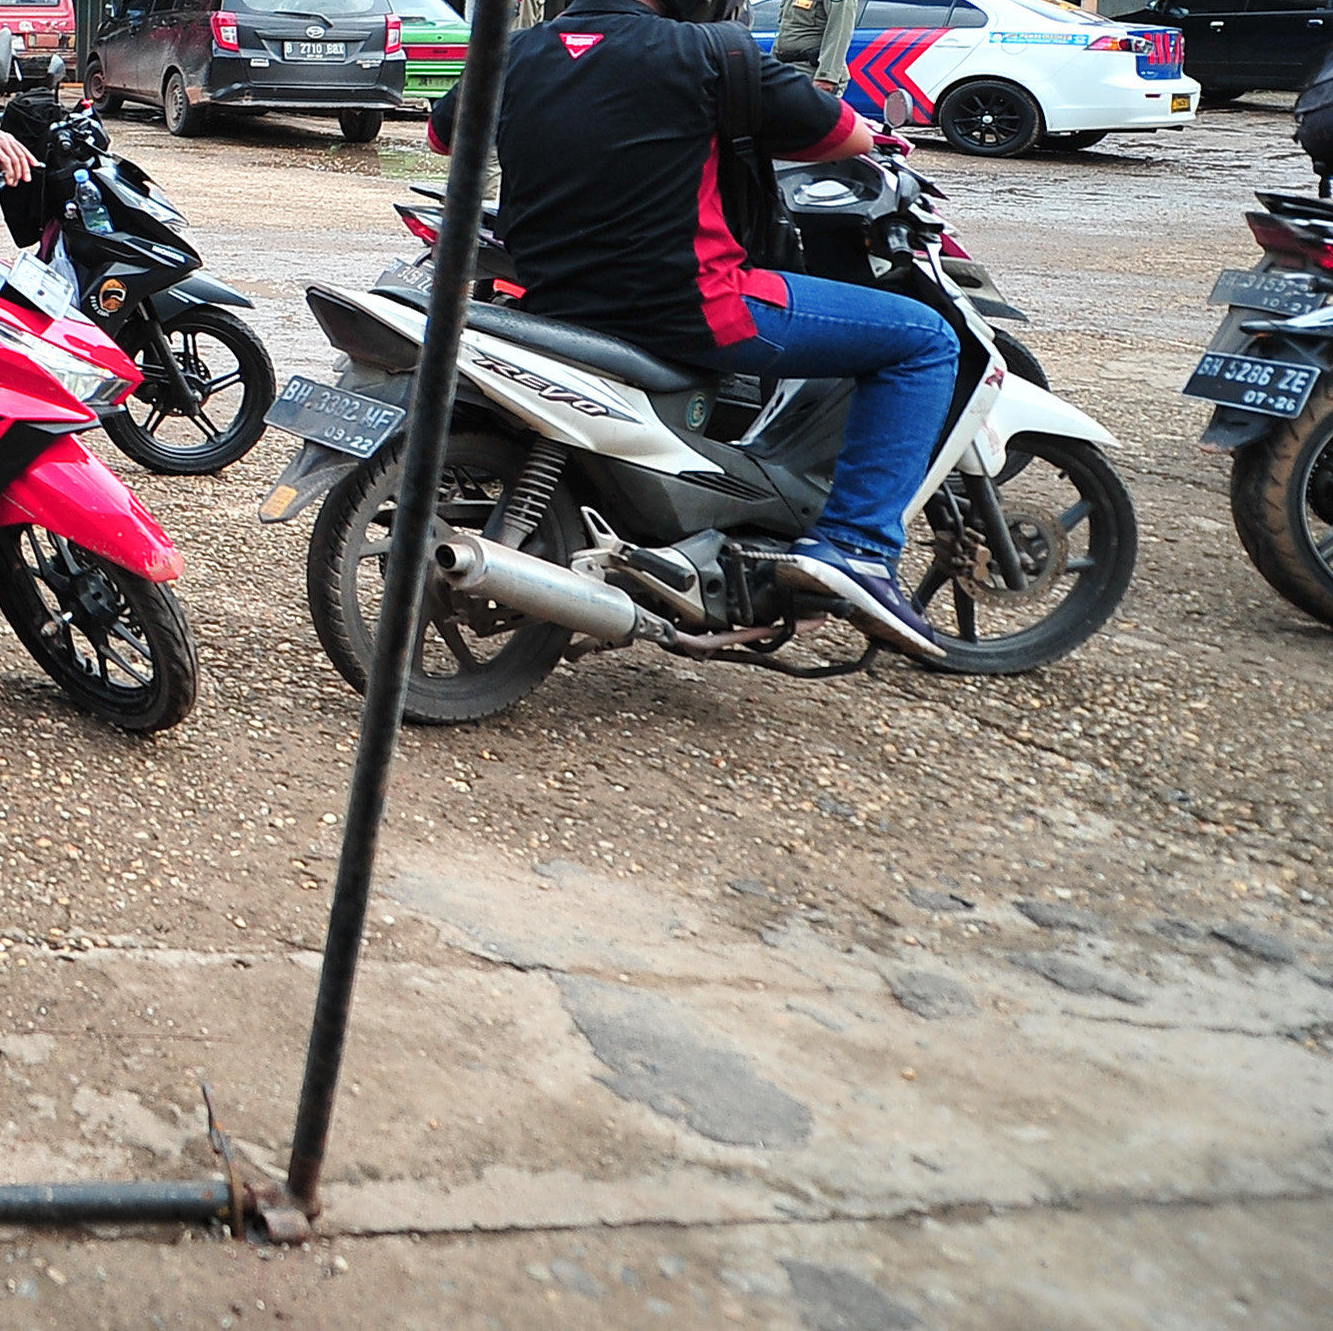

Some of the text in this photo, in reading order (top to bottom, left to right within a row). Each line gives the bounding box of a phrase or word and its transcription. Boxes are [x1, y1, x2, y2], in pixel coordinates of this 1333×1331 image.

[285, 41, 293, 54] B
[299, 42, 323, 55] 2710
[471, 354, 610, 417] REVO
[1196, 356, 1310, 394] BH 5286 ZE
[282, 379, 314, 406] BH
